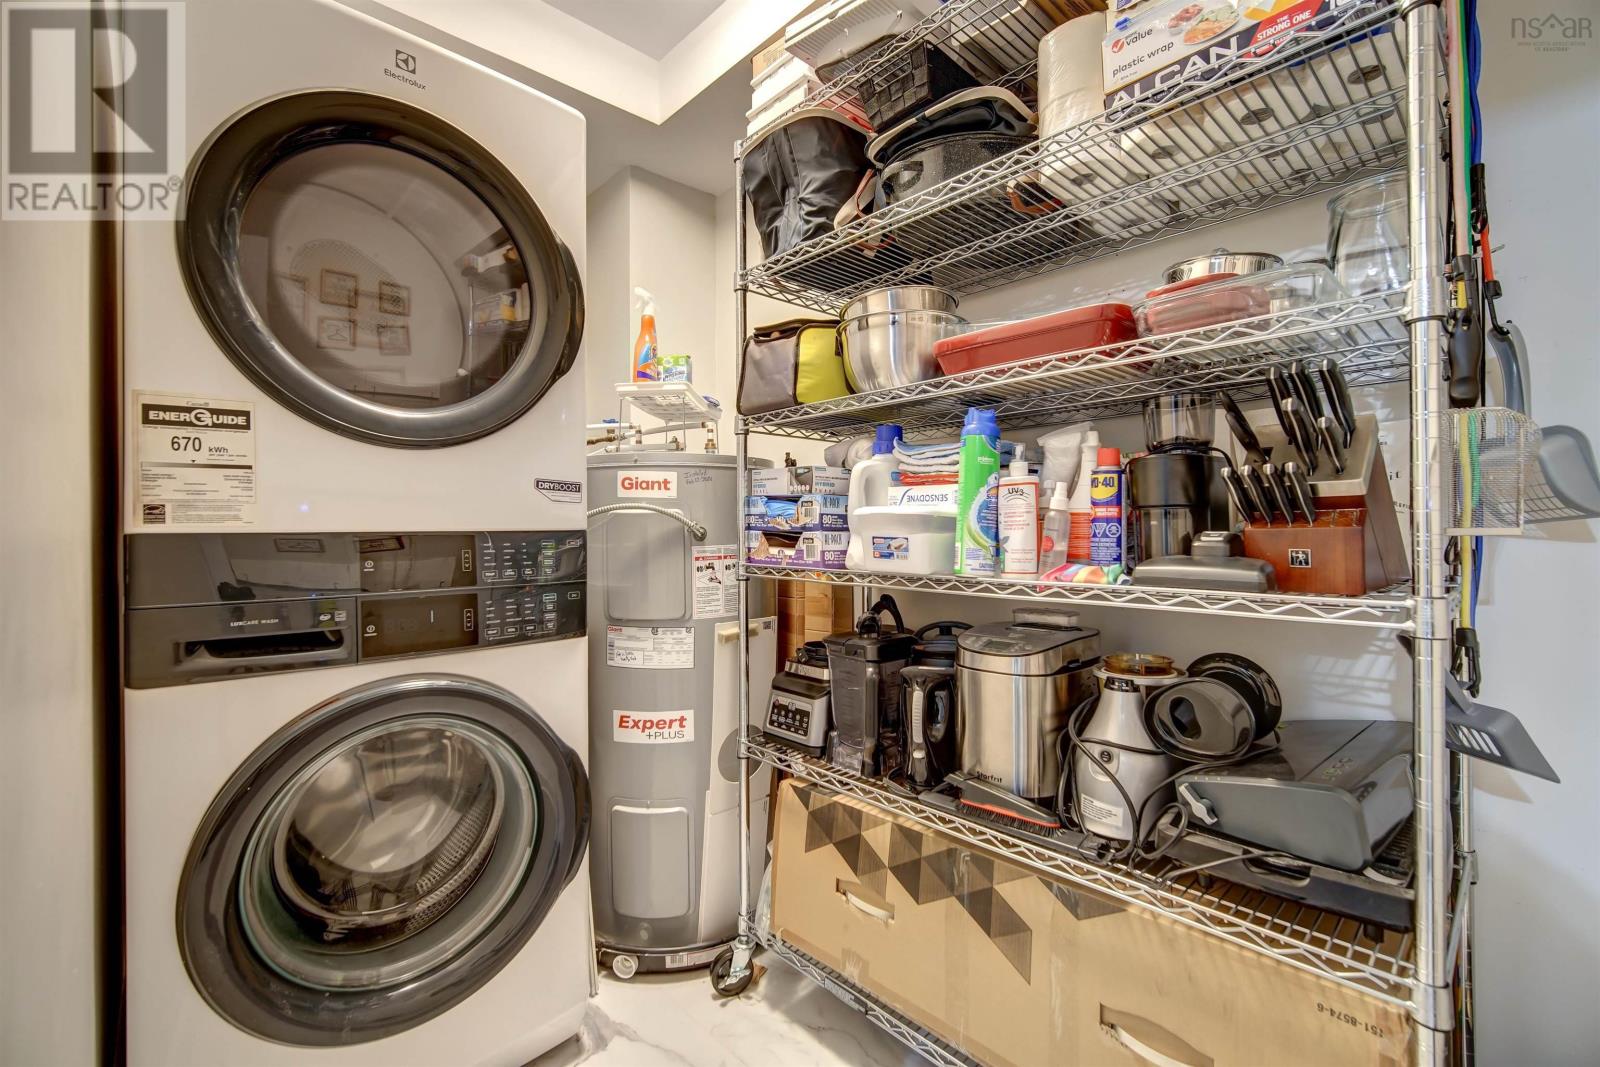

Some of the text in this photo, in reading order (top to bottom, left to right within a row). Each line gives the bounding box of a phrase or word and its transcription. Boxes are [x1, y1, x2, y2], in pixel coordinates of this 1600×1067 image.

[1257, 20, 1291, 40] STRONG
[1293, 10, 1311, 24] ONE
[1126, 28, 1153, 46] value
[1112, 41, 1174, 78] plastic wrap
[384, 68, 426, 90] Electrolux
[148, 408, 247, 426] ENERGUIDE
[171, 436, 202, 452] 670
[538, 482, 580, 492] DRYBOOST
[621, 476, 671, 491] Giant
[906, 494, 949, 502] SENSODYNE
[822, 515, 832, 524] 80
[824, 551, 834, 561] 80
[618, 715, 687, 733] Expert
[646, 730, 685, 740] +PLUS
